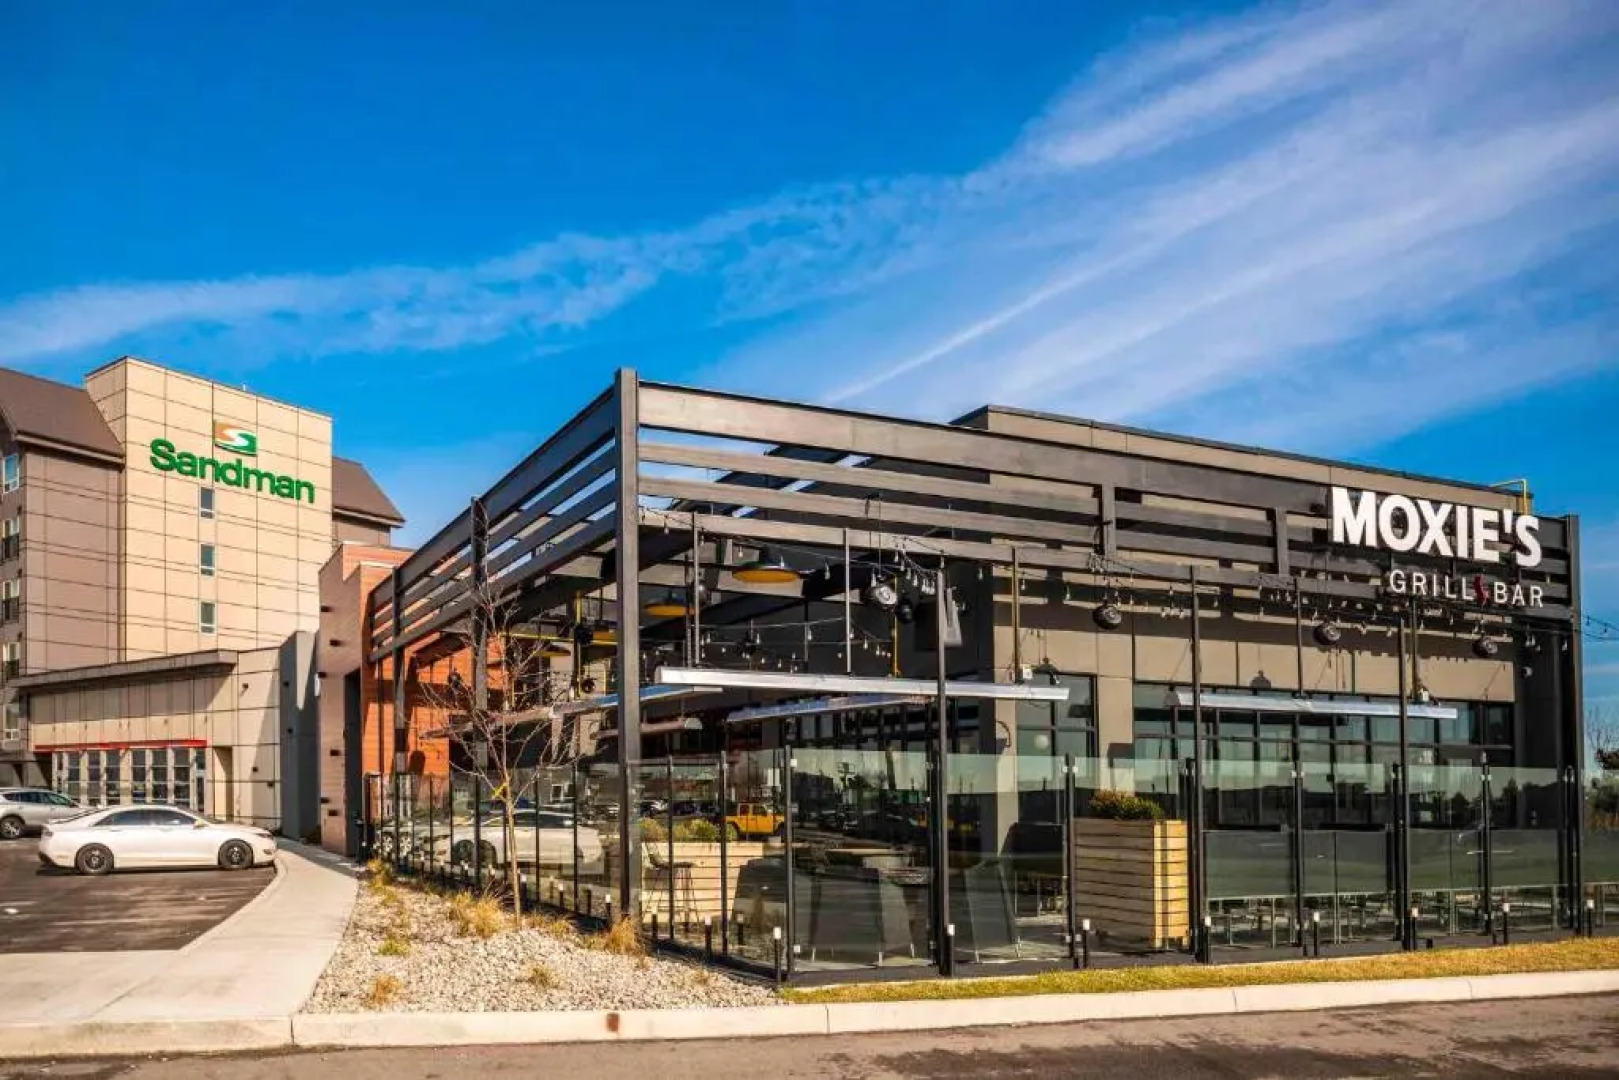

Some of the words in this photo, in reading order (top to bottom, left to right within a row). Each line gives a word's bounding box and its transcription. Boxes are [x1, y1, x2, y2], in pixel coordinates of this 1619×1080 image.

[150, 438, 315, 503] Sandman
[1331, 486, 1543, 567] MOXIE'S
[1389, 569, 1474, 601] GRILL
[1493, 581, 1544, 608] BAR
